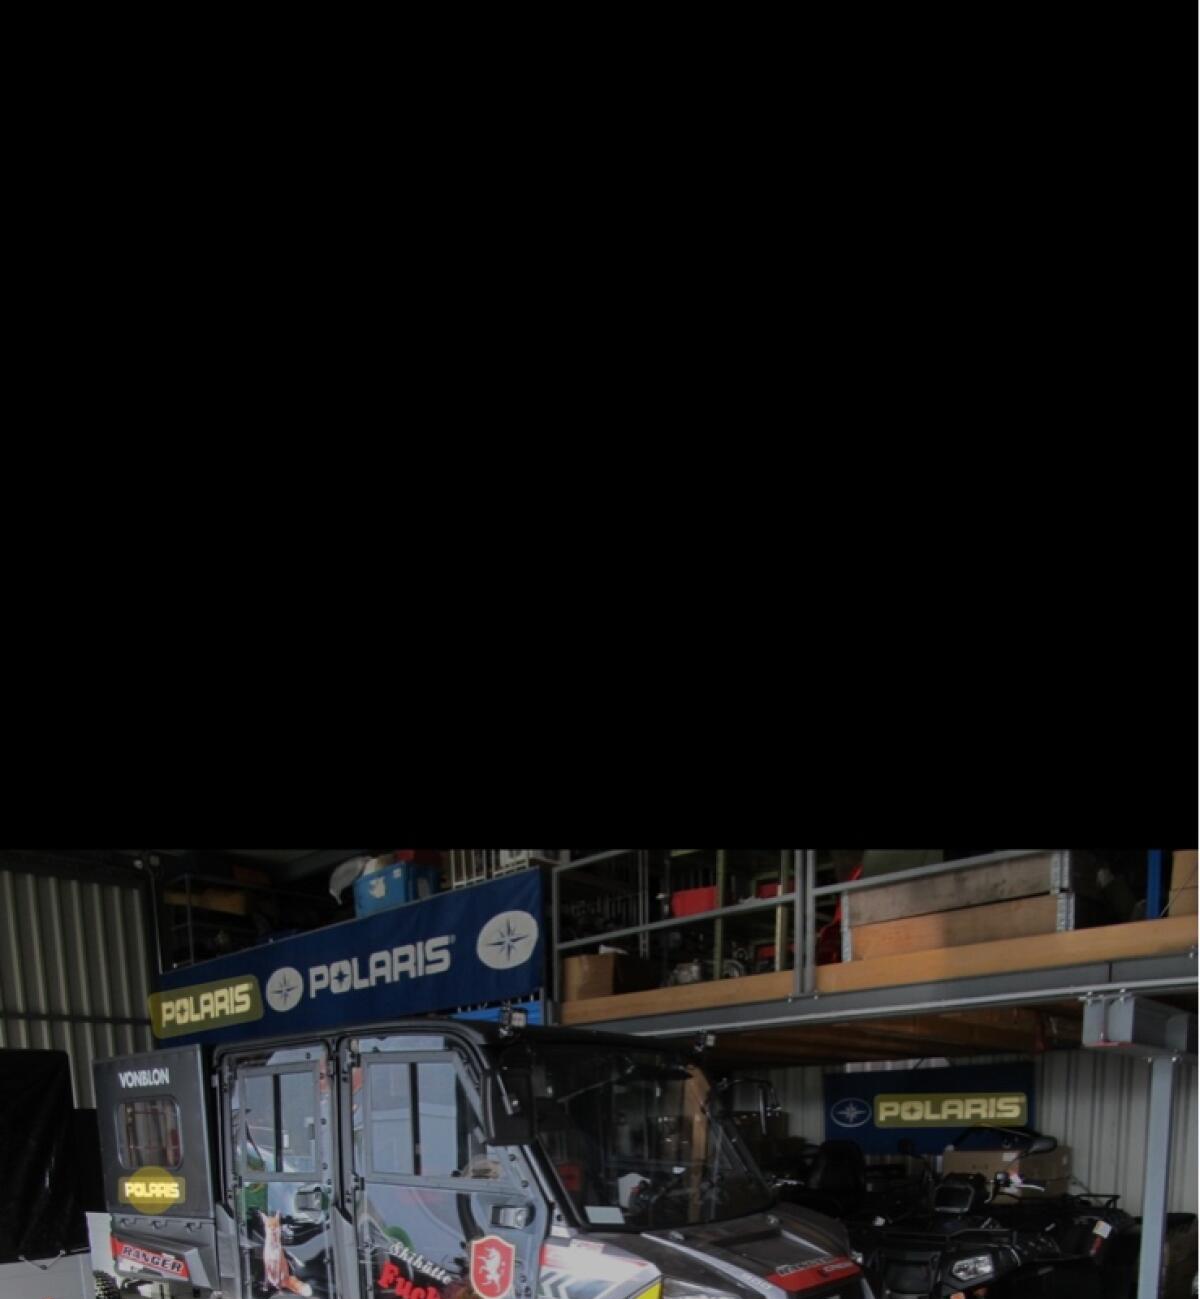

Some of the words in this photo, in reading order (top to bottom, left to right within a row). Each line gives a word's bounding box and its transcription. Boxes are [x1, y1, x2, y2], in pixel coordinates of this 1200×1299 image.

[308, 935, 454, 1000] POLARIS
[160, 983, 253, 1028] POLARIS
[118, 1067, 170, 1088] VONBLON
[879, 1097, 1022, 1121] POLARIS
[124, 1181, 180, 1198] POLARIS
[122, 1244, 183, 1273] RANGER
